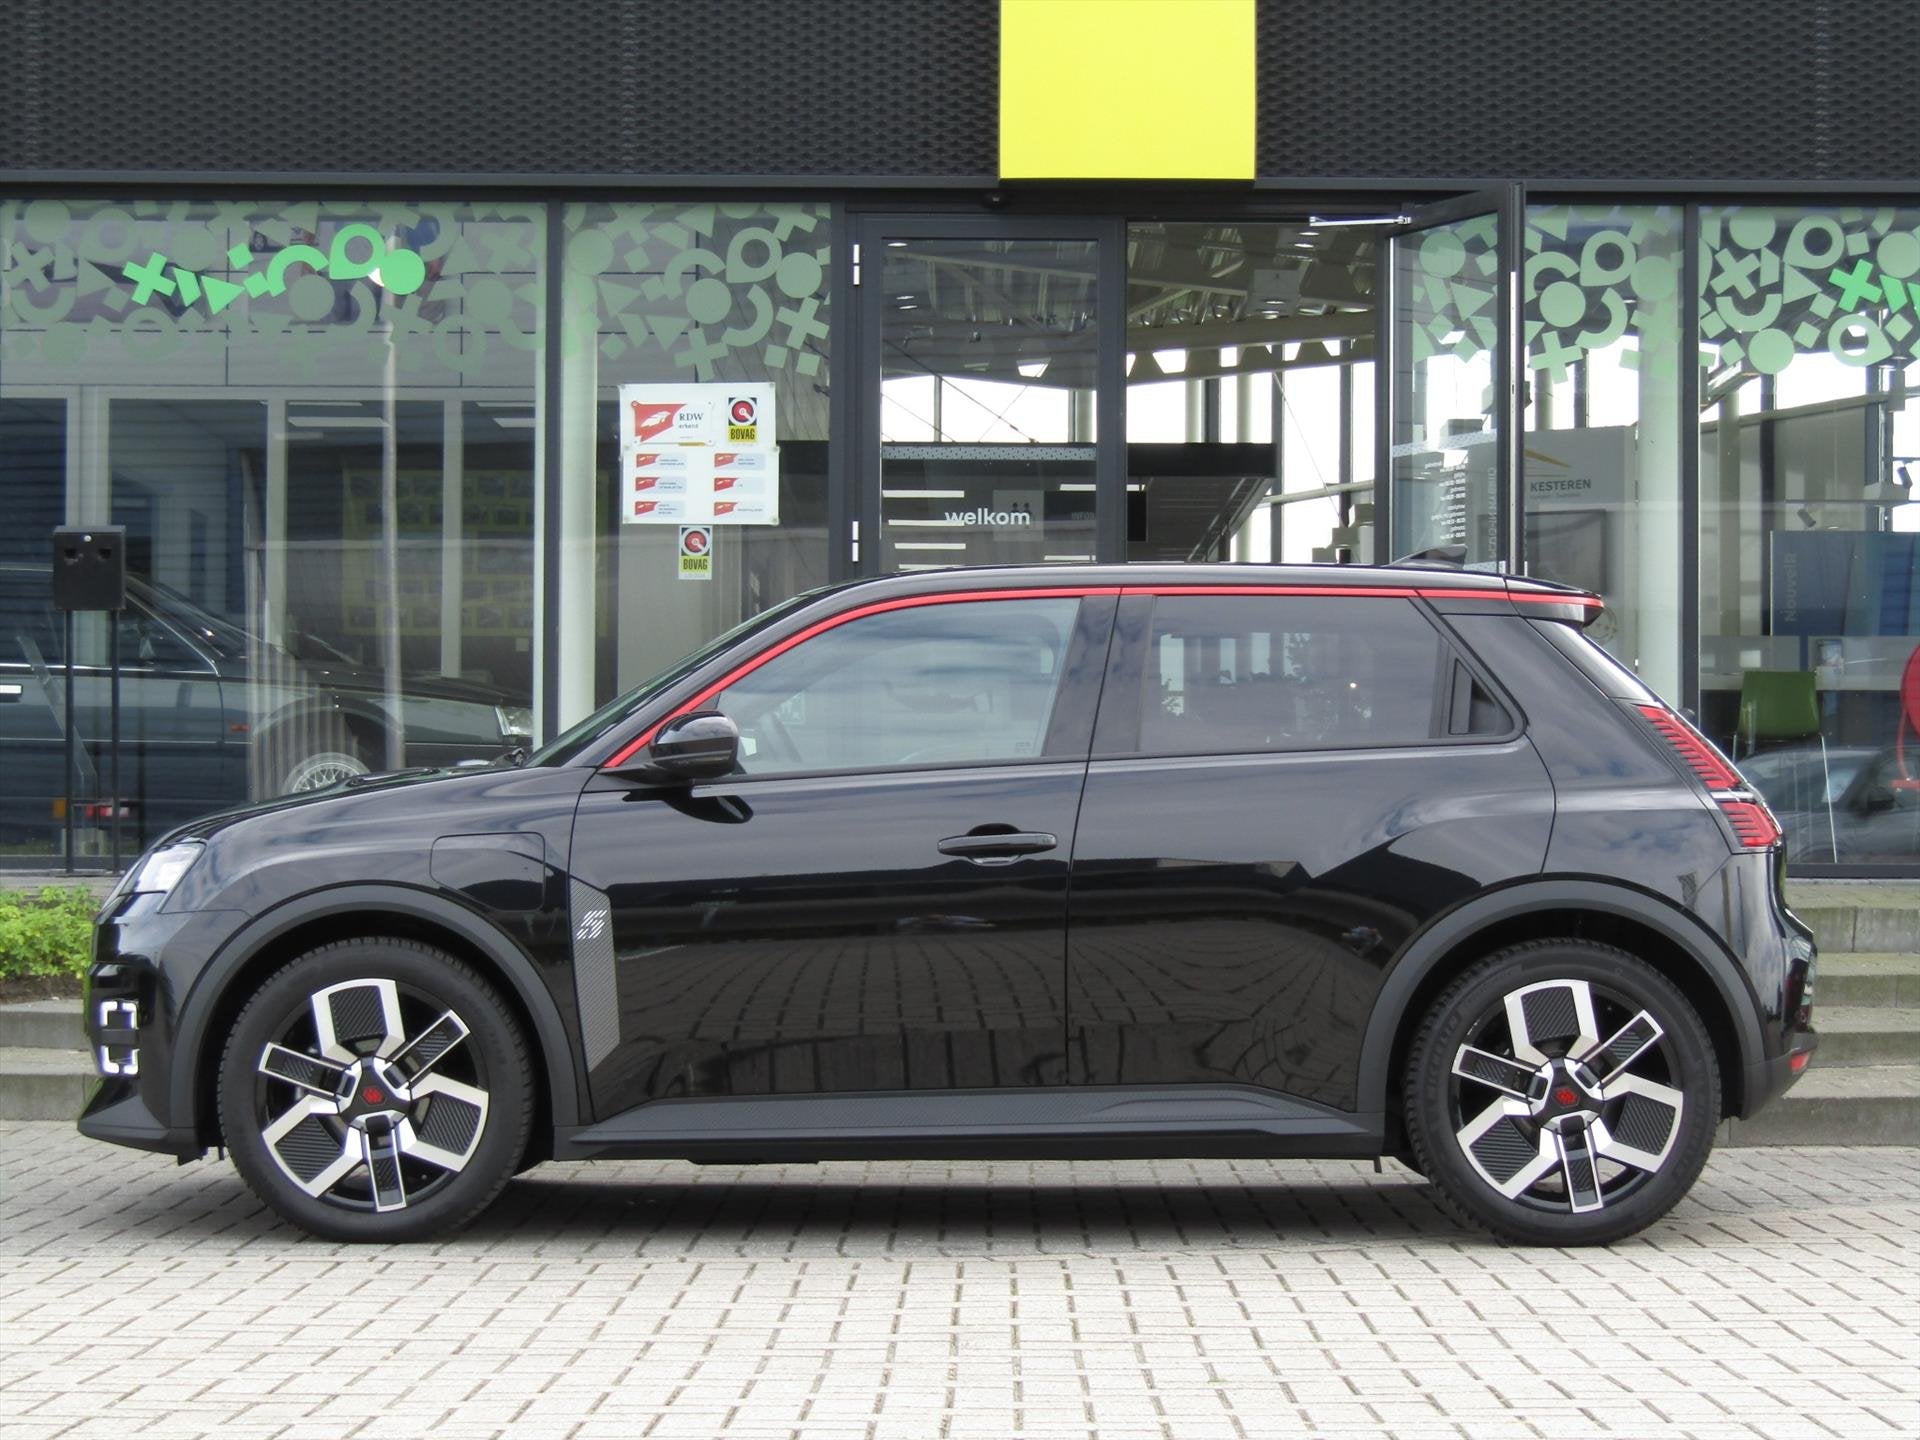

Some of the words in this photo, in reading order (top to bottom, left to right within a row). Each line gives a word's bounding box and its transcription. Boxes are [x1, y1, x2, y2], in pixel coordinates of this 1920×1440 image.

[679, 412, 704, 421] RDW
[730, 428, 755, 440] BOVAG
[1530, 478, 1592, 492] KESTEREN
[945, 508, 1030, 525] welkom
[683, 558, 708, 570] BOVAG
